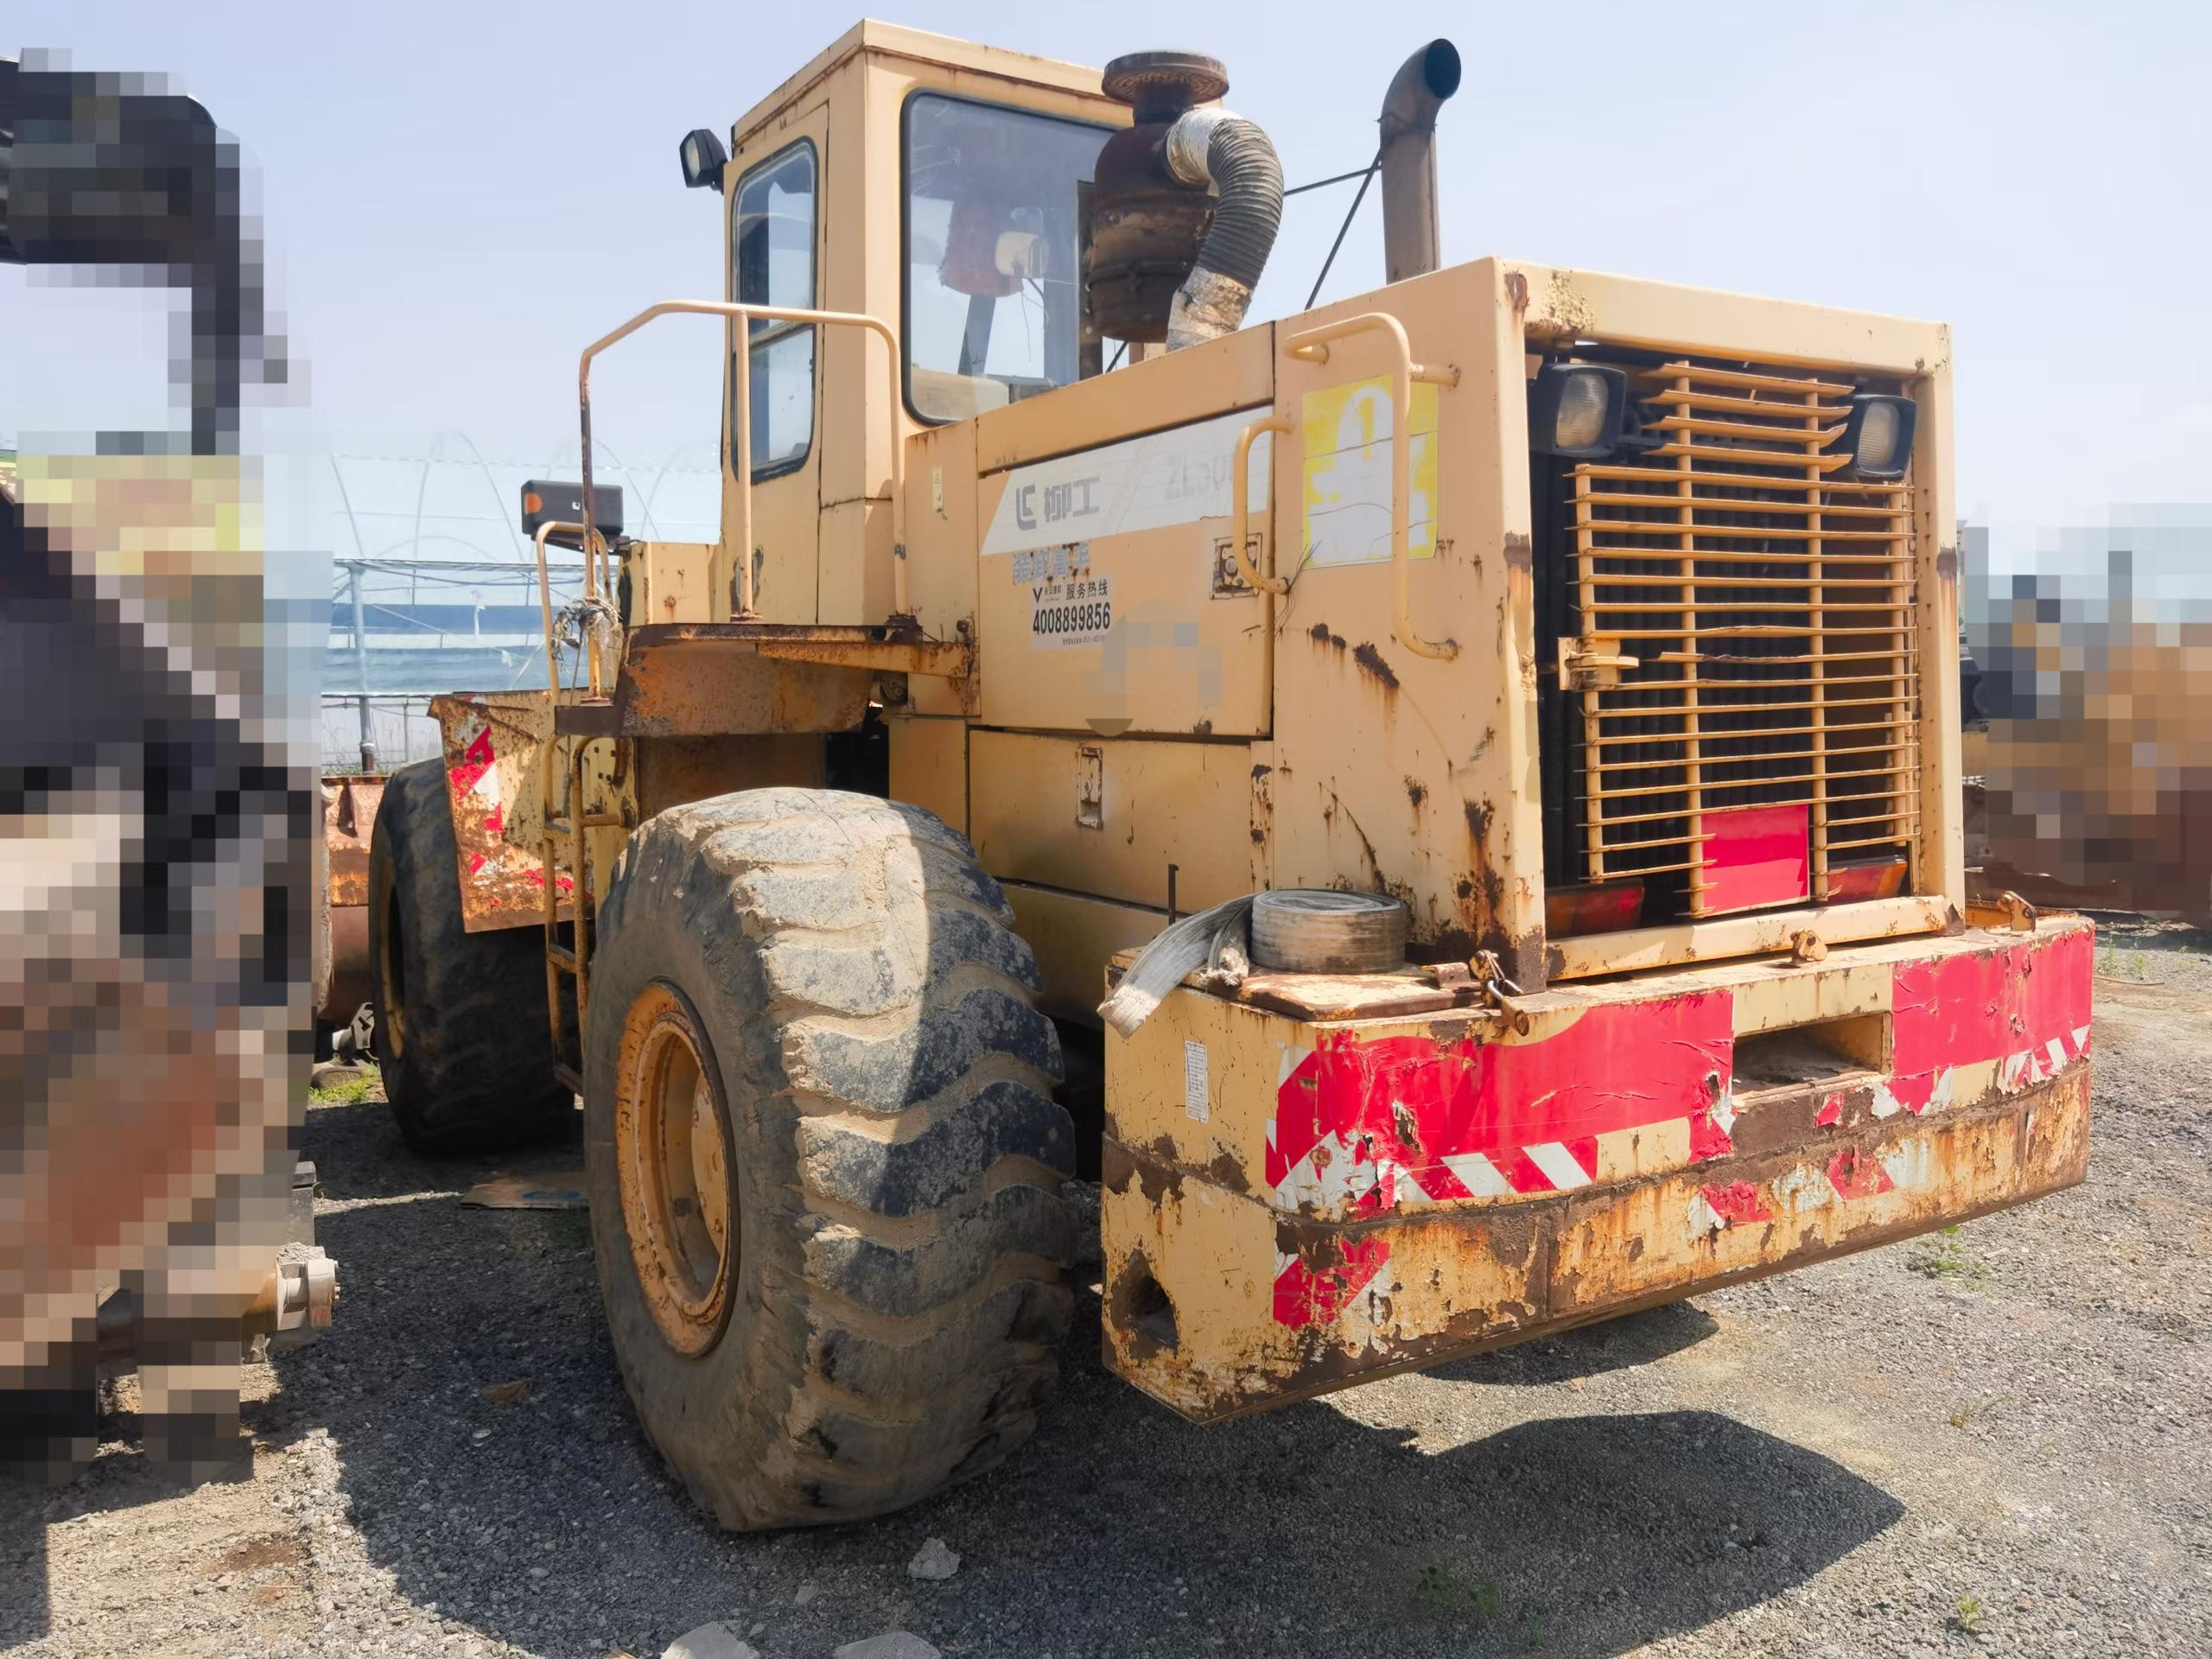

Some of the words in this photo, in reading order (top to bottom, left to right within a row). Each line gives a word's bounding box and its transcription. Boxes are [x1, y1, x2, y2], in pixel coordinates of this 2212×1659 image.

[1043, 476, 1100, 523] 柳工
[1066, 579, 1108, 601] 服务热线
[1033, 602, 1110, 634] 4008899856
